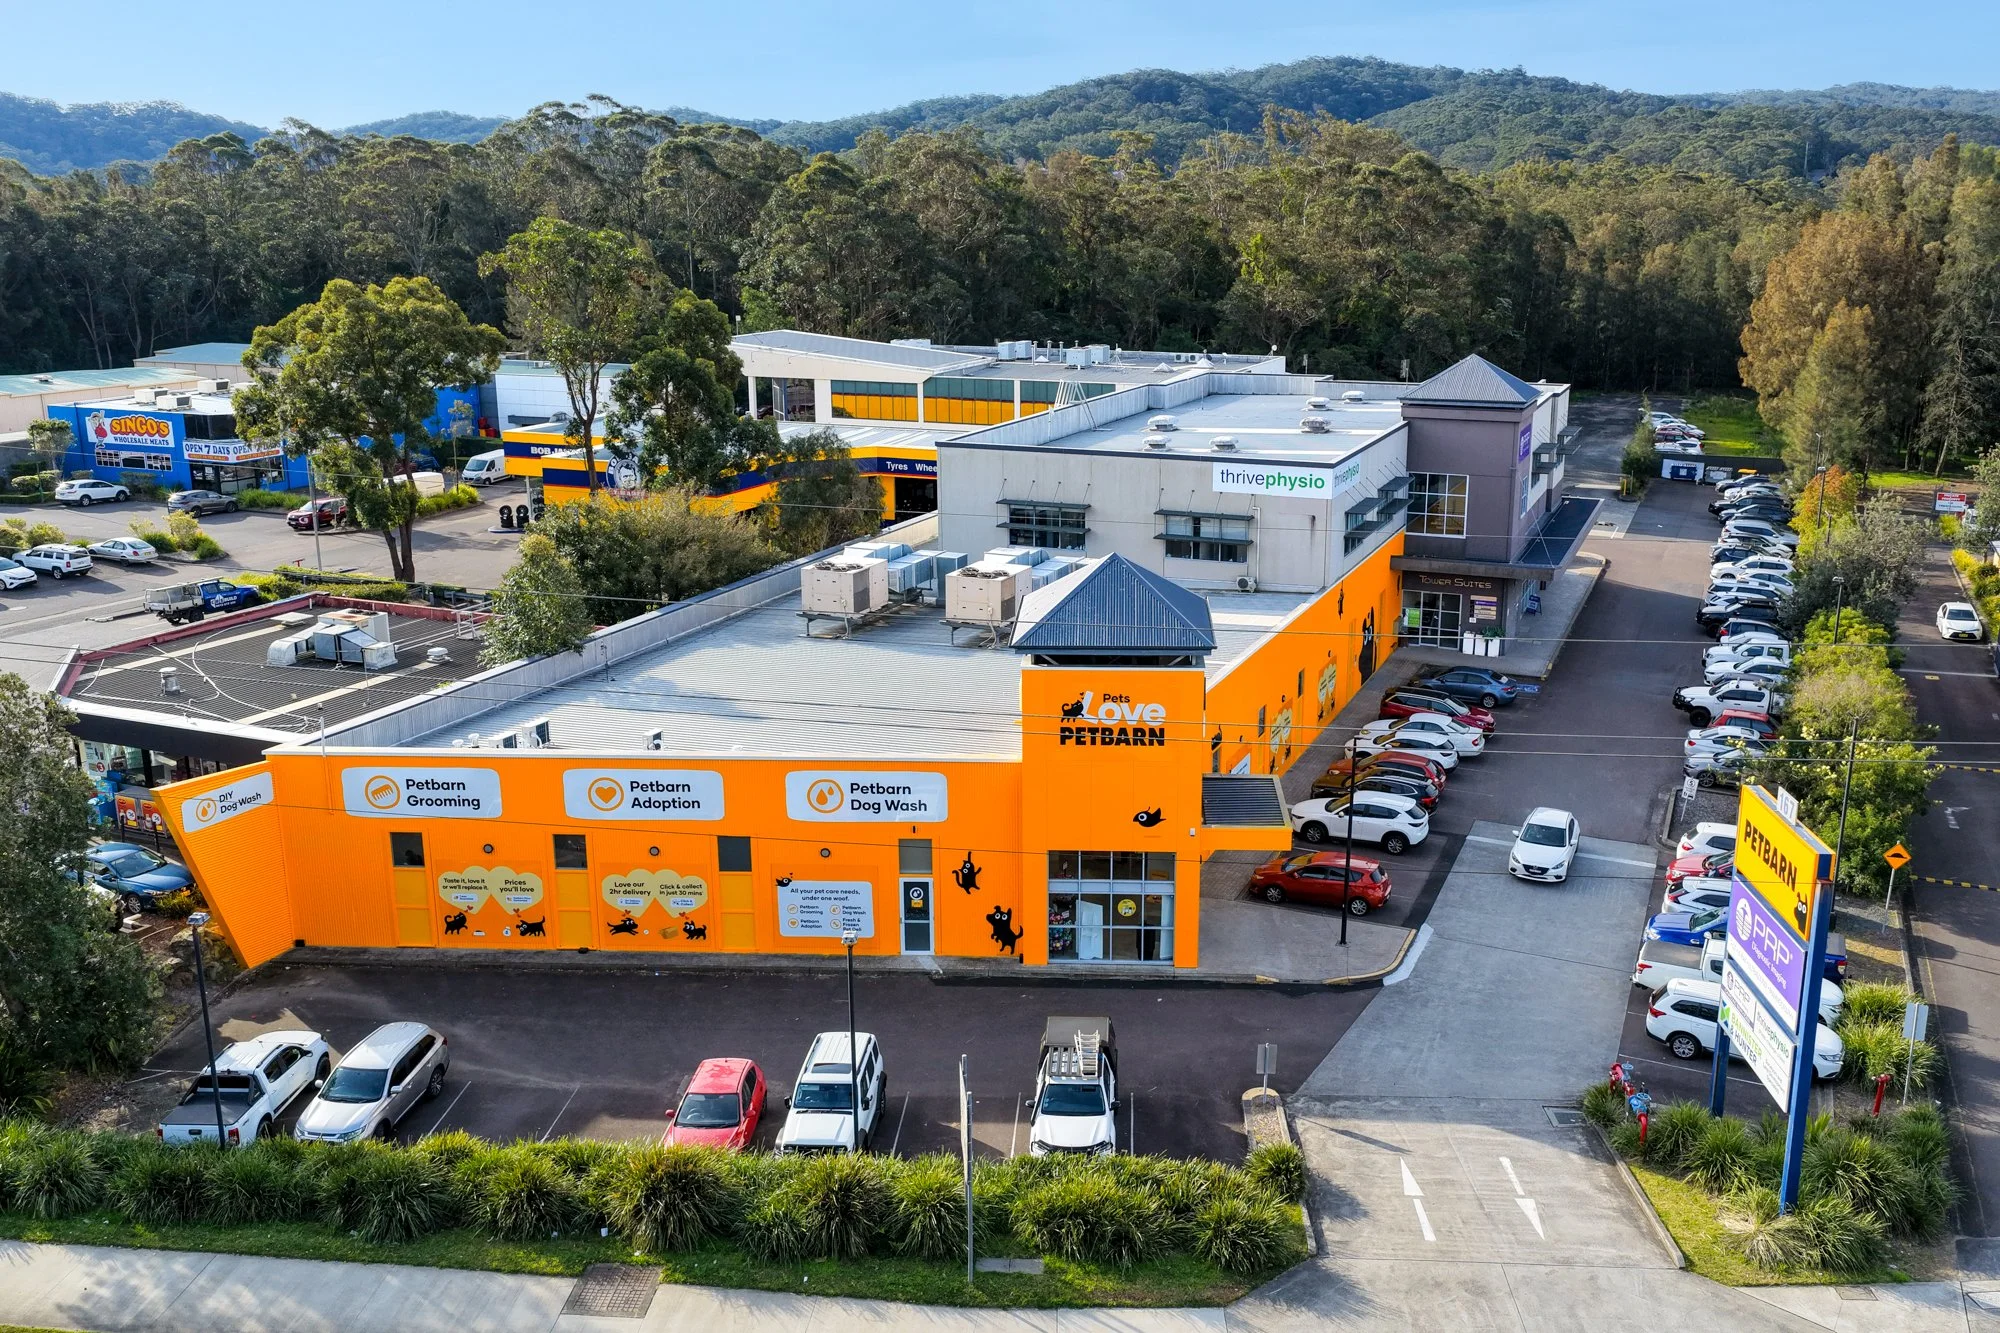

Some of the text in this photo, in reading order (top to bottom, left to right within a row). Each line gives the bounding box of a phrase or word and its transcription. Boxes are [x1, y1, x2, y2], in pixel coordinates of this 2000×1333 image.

[110, 416, 170, 437] SINGO'S
[113, 436, 170, 446] WHOLESALE MEATS
[184, 443, 203, 452] OPEN
[204, 444, 211, 454] 7
[213, 445, 230, 455] DAYS
[530, 446, 551, 455] BOB
[885, 461, 909, 471] Tyres
[1220, 468, 1326, 492] thrivephysio
[1103, 693, 1131, 703] Pets
[1081, 690, 1167, 726] Love
[1060, 726, 1165, 747] PETBARN
[405, 778, 466, 791] Petbarn
[629, 780, 691, 793] Petbarn
[850, 782, 912, 795] Petbarn
[219, 790, 234, 803] DIY
[220, 792, 262, 814] Dog Wash
[406, 795, 481, 810] Grooming
[631, 797, 701, 811] Adoption
[850, 799, 928, 814] Dog Wash
[1779, 792, 1795, 819] 167
[1743, 818, 1798, 892] PETBARN
[1753, 913, 1790, 965] PRP
[1731, 1012, 1762, 1056] BANNISTER
[1734, 1030, 1757, 1066] HUNTER
